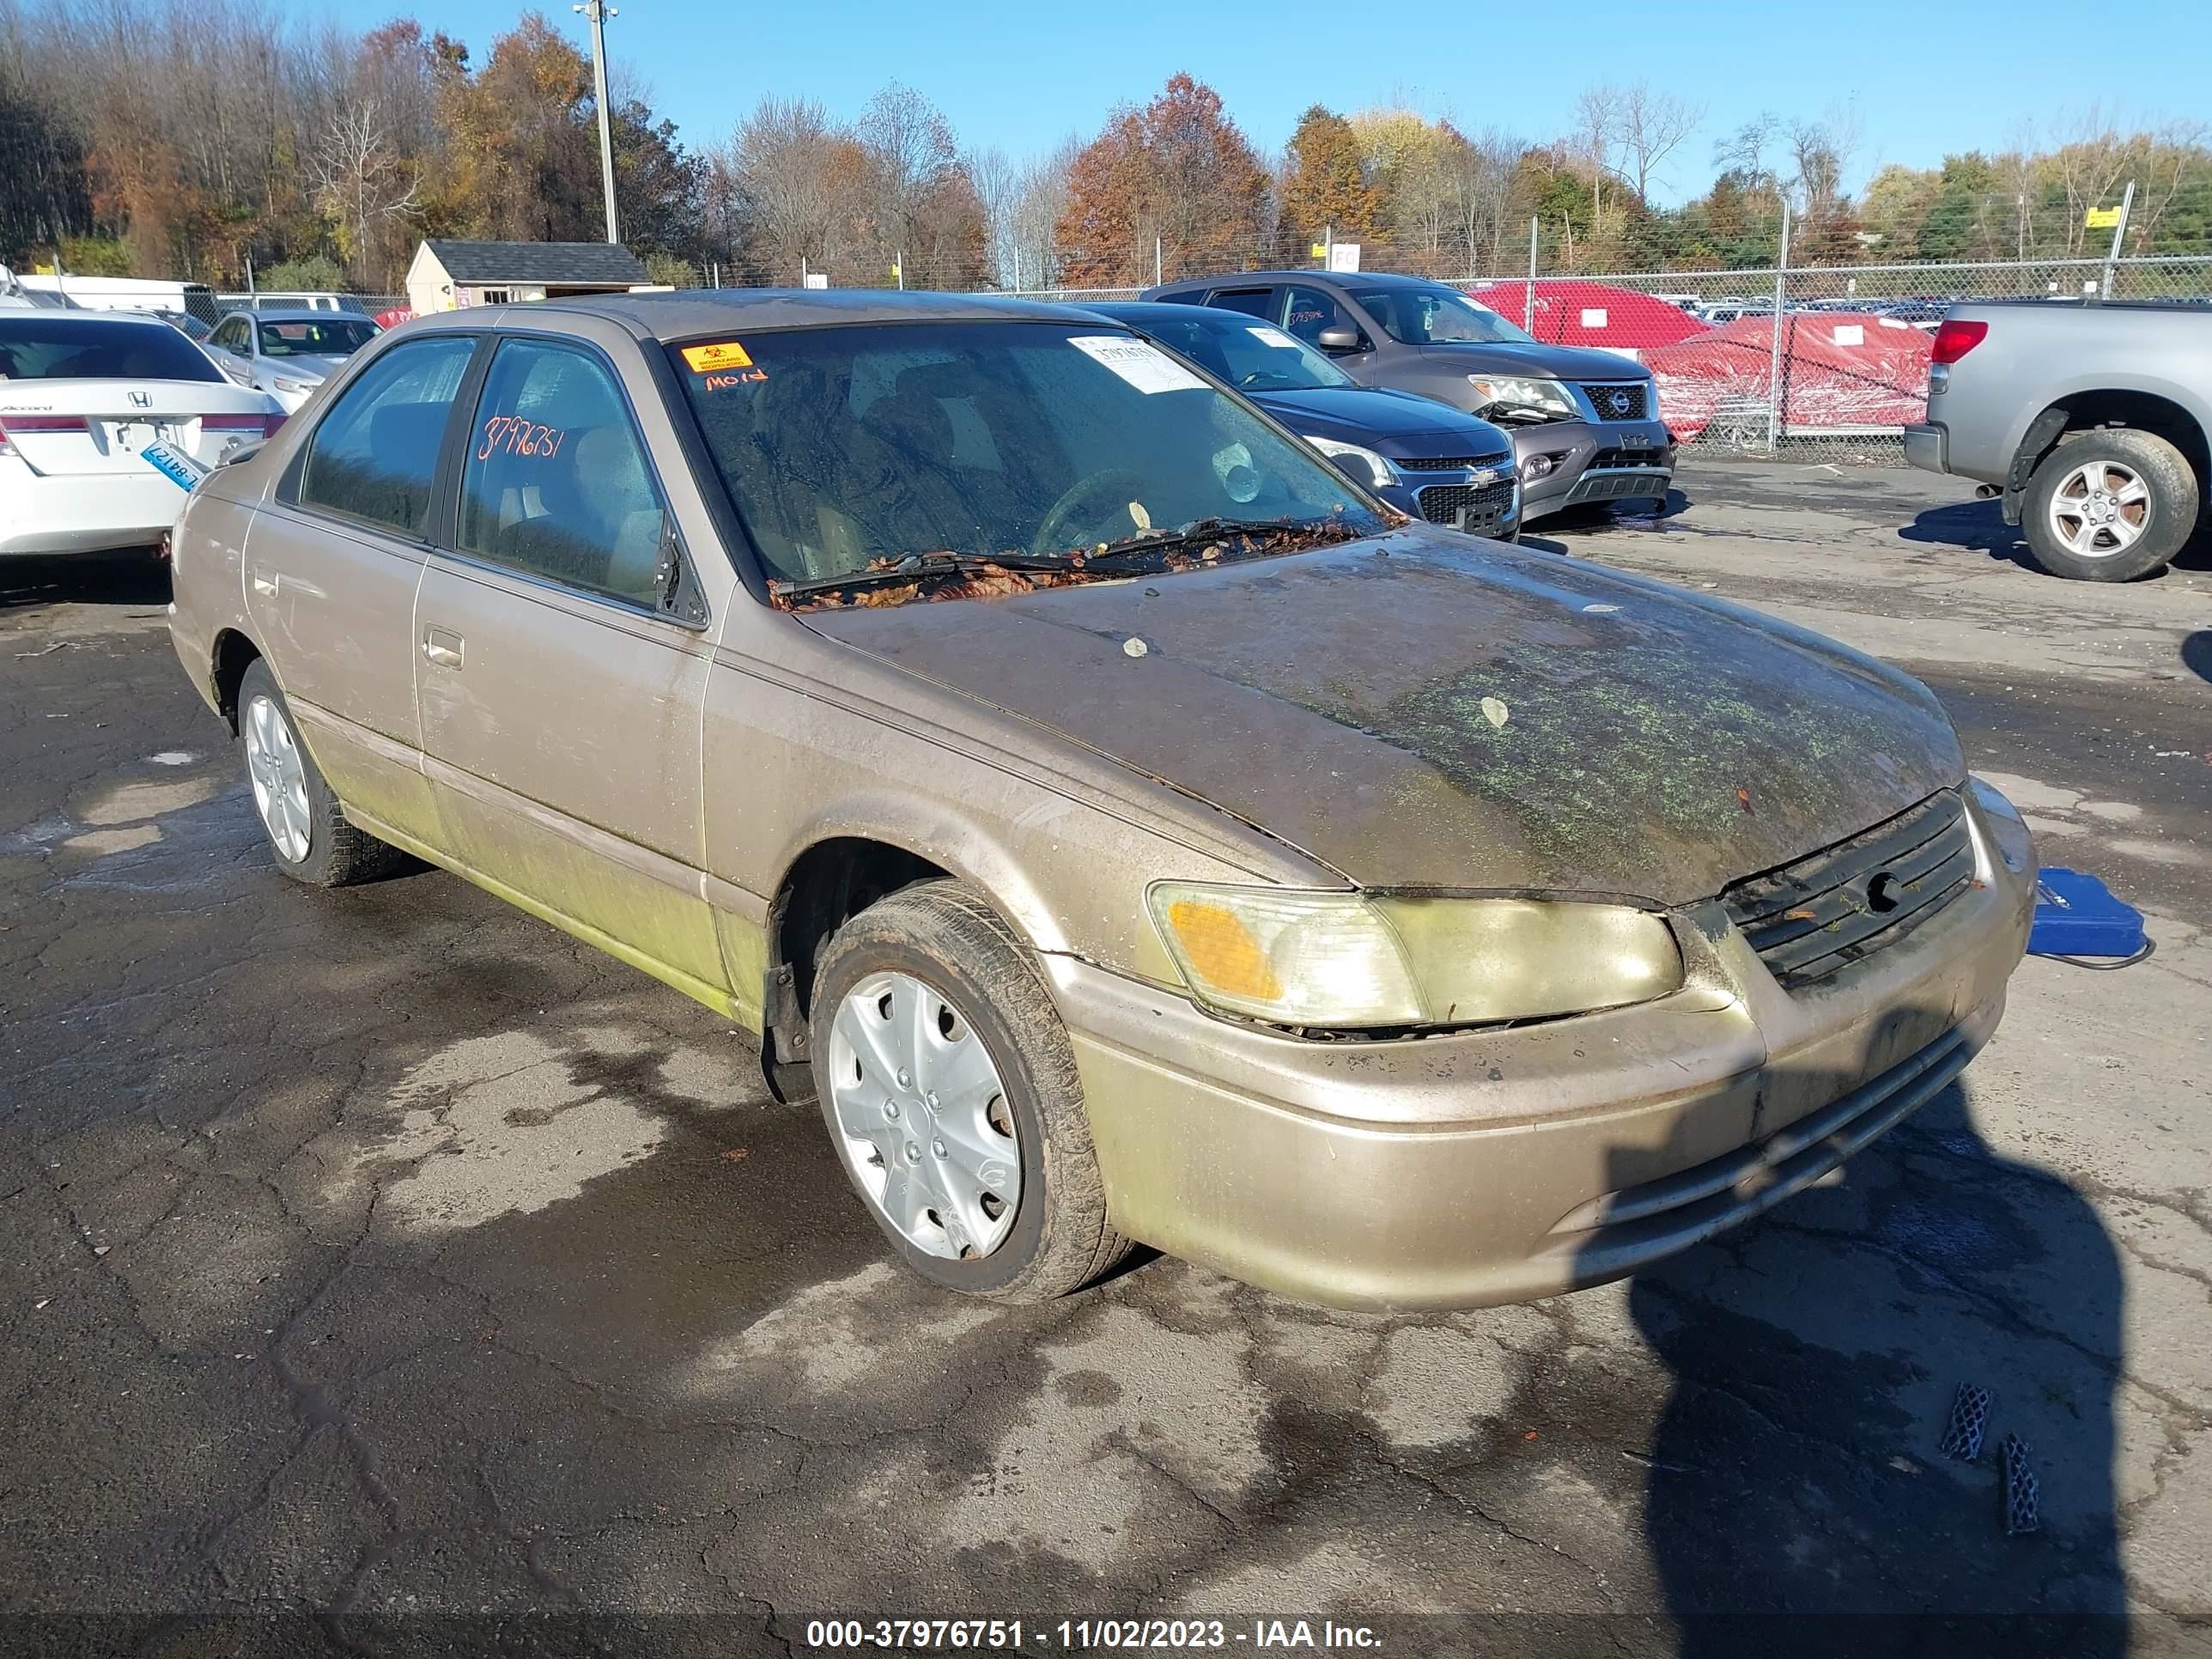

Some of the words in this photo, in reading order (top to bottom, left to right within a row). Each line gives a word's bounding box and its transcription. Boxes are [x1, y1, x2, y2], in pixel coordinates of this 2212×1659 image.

[1095, 348, 1158, 360] 37976751
[478, 416, 564, 460] 37976751
[149, 446, 199, 488] L-84127
